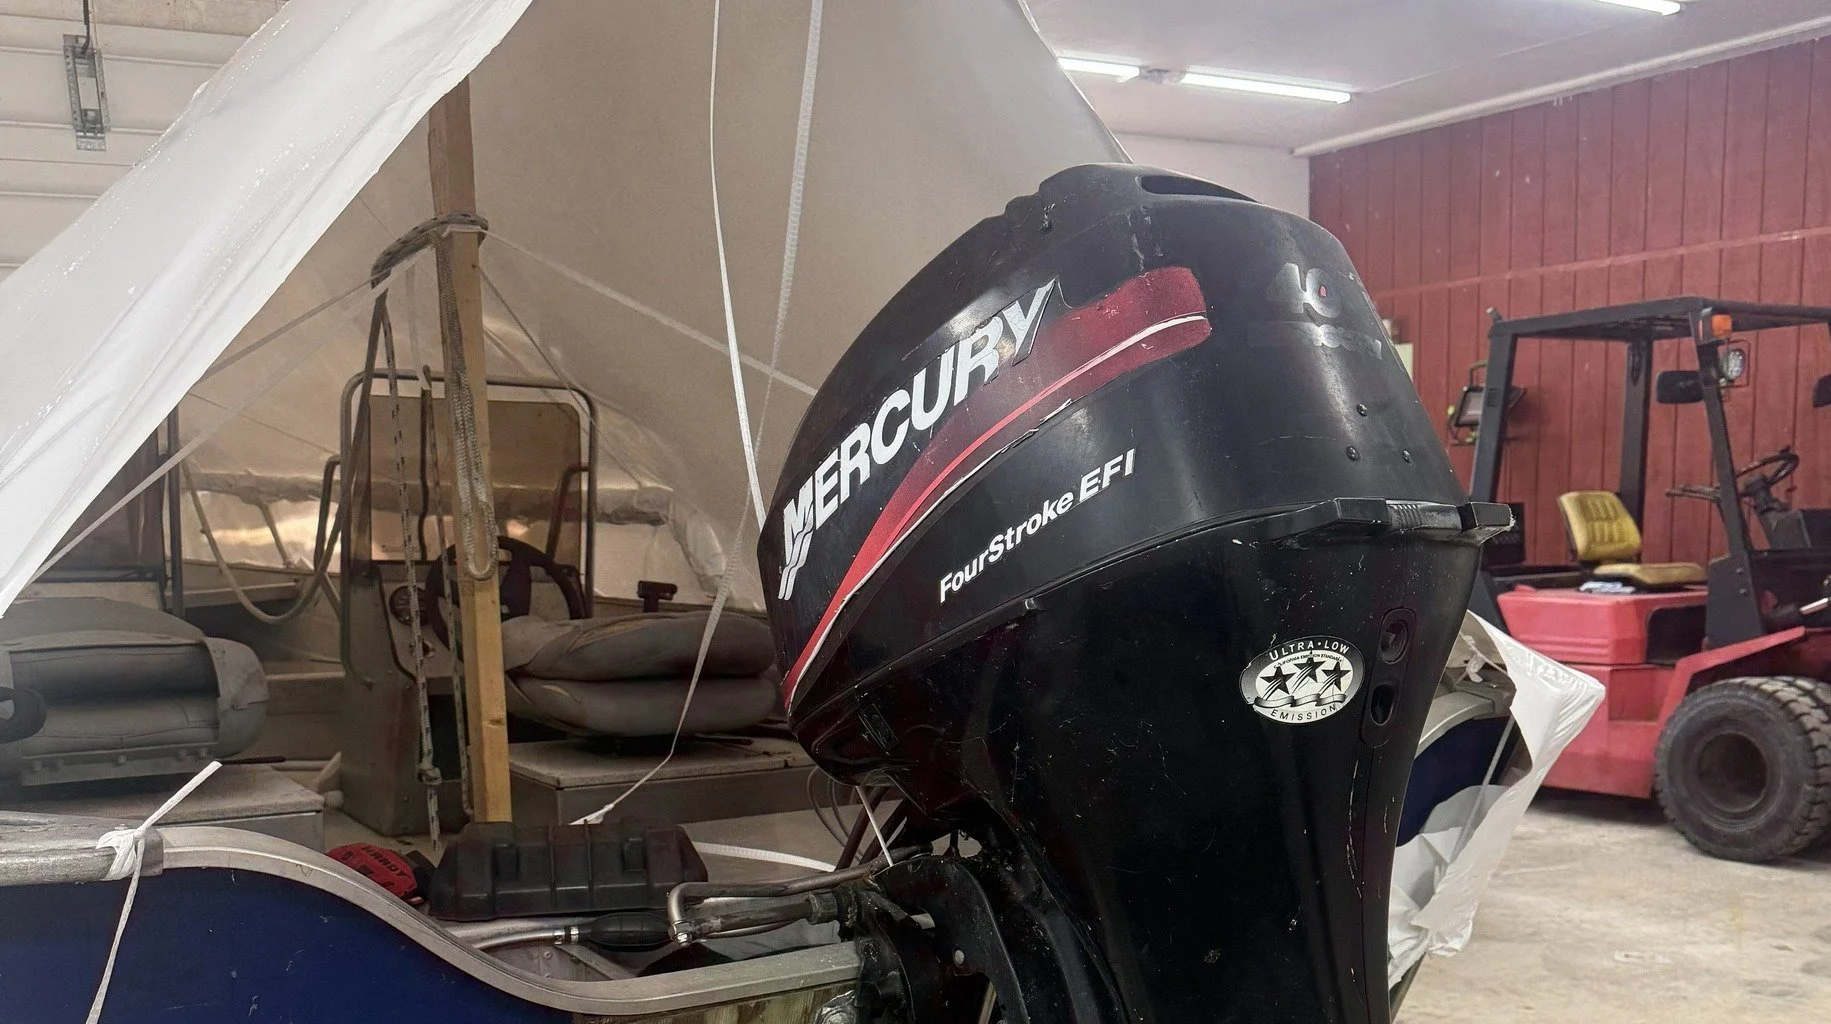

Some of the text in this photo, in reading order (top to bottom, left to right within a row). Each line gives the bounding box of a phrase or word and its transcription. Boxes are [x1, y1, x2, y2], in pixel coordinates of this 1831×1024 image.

[777, 277, 1057, 601] MERCURY
[939, 448, 1136, 604] FourStroke EFI
[1270, 704, 1336, 721] EMISSION
